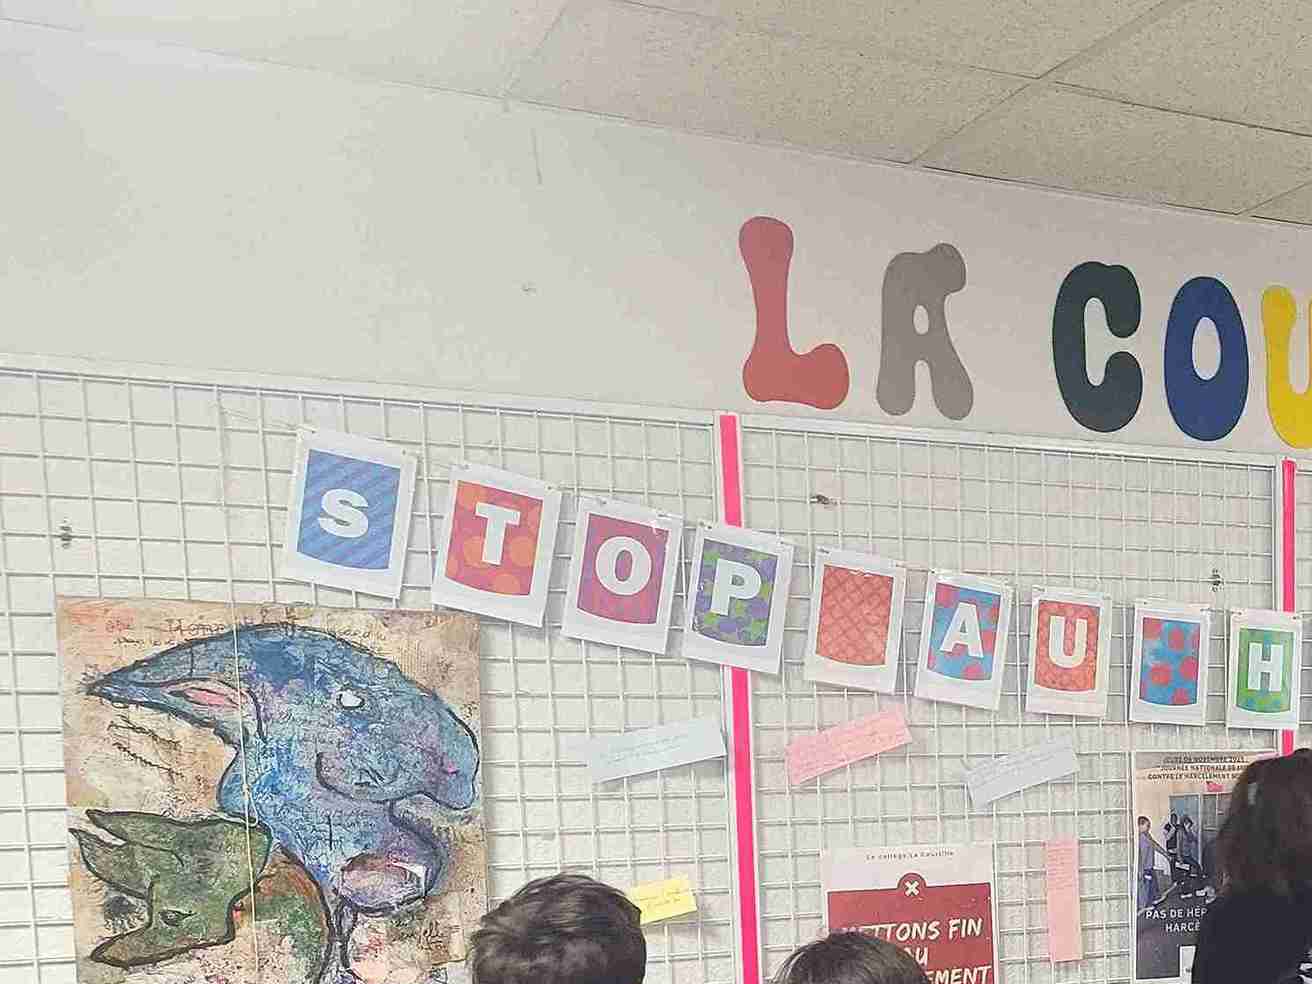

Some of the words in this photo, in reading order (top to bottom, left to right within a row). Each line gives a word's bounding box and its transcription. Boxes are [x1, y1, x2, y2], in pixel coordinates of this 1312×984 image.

[739, 216, 974, 421] LA
[319, 488, 762, 615] STOP
[941, 604, 1090, 669] AU
[948, 918, 983, 938] FIN
[1146, 910, 1166, 919] PAS
[1170, 909, 1183, 918] DE
